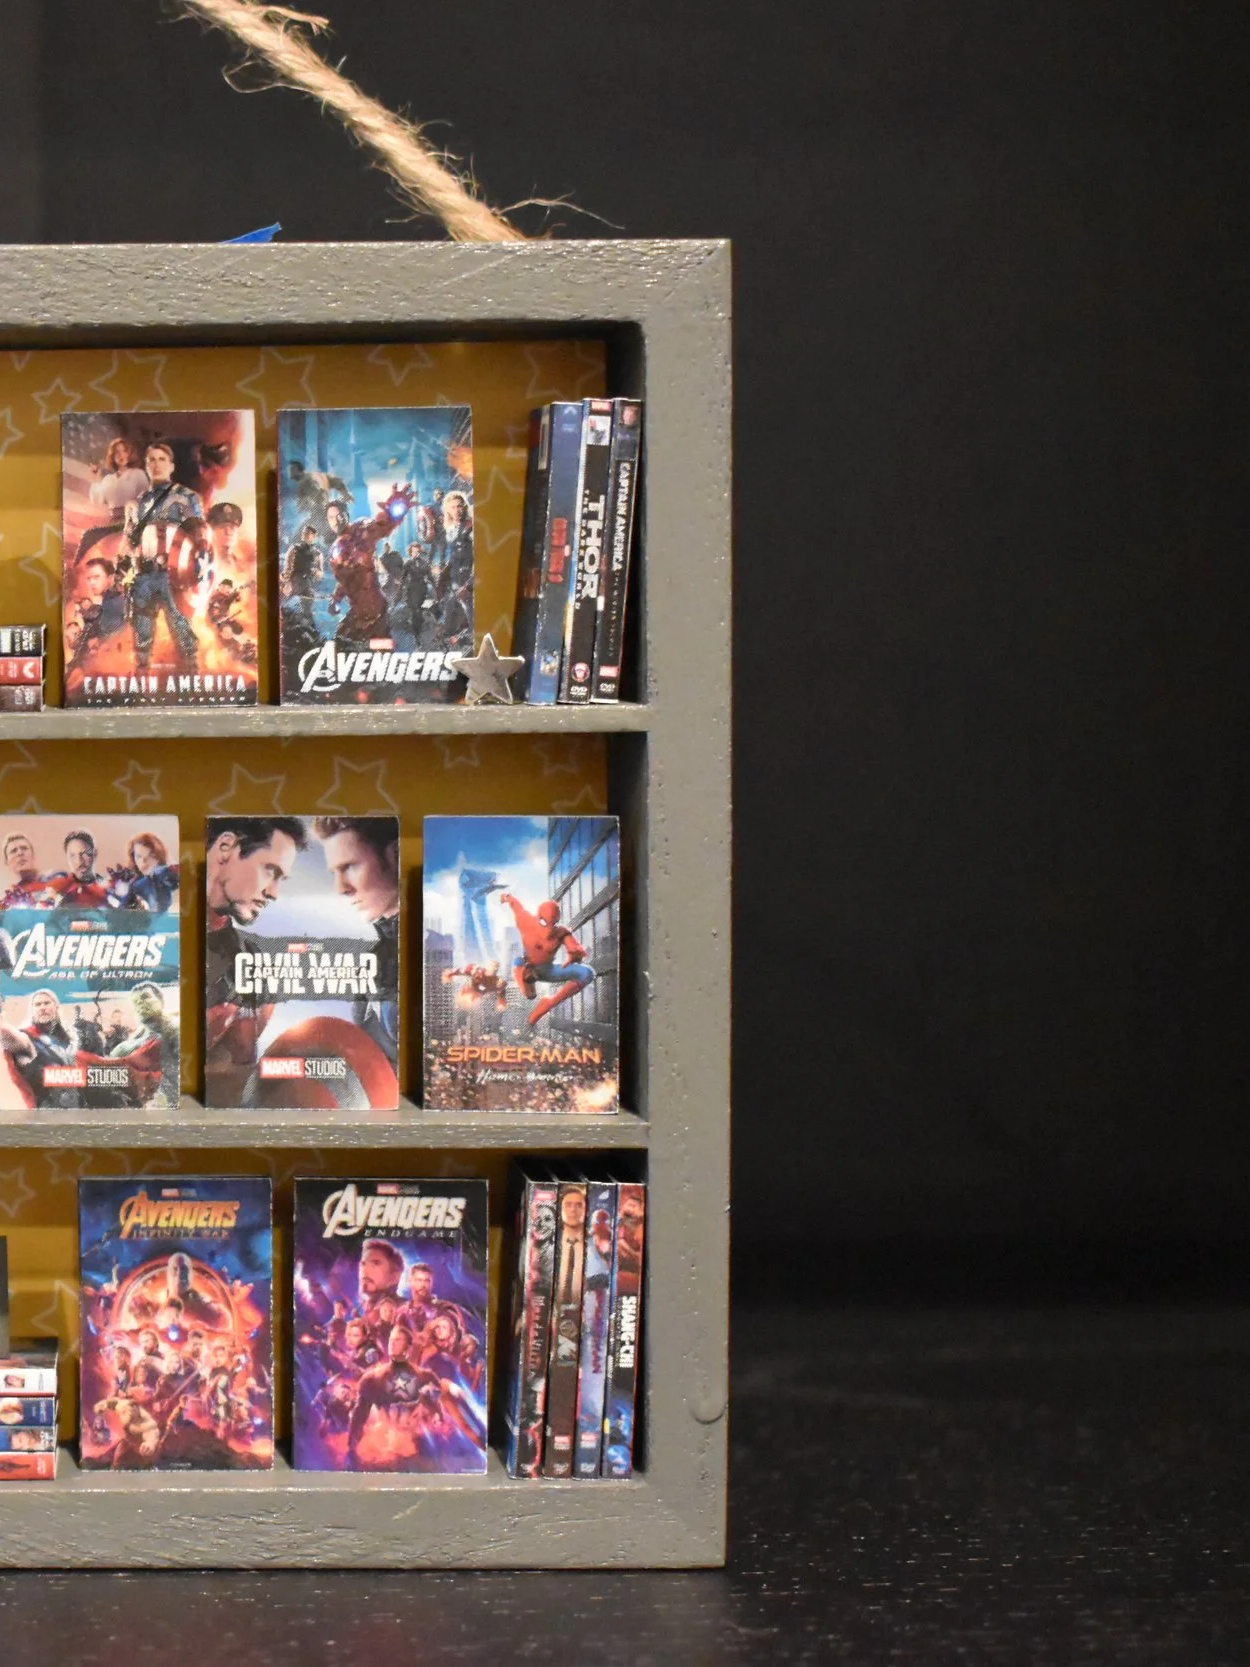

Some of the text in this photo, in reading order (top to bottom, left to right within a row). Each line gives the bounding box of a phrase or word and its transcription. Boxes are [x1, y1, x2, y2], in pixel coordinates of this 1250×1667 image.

[616, 462, 631, 515] CAPTAIN
[581, 494, 606, 599] THOR
[611, 516, 628, 571] AMERICA
[84, 675, 247, 694] CAPTAIN AMERICA
[298, 640, 462, 693] AVENGERS
[12, 923, 166, 978] AVENGERS
[235, 953, 378, 995] CIVIL WAR
[245, 967, 371, 979] CAPTAIN AMERICA
[44, 1067, 129, 1086] MARVEL STUDIOS
[262, 1058, 346, 1078] MARVEL STUDIOS
[446, 1047, 602, 1065] SPIDER-MAN
[119, 1191, 240, 1239] AVENGERS
[323, 1184, 466, 1238] AVENGERS
[364, 1229, 456, 1238] ENDGAME
[620, 1295, 637, 1369] SHANG-CHI
